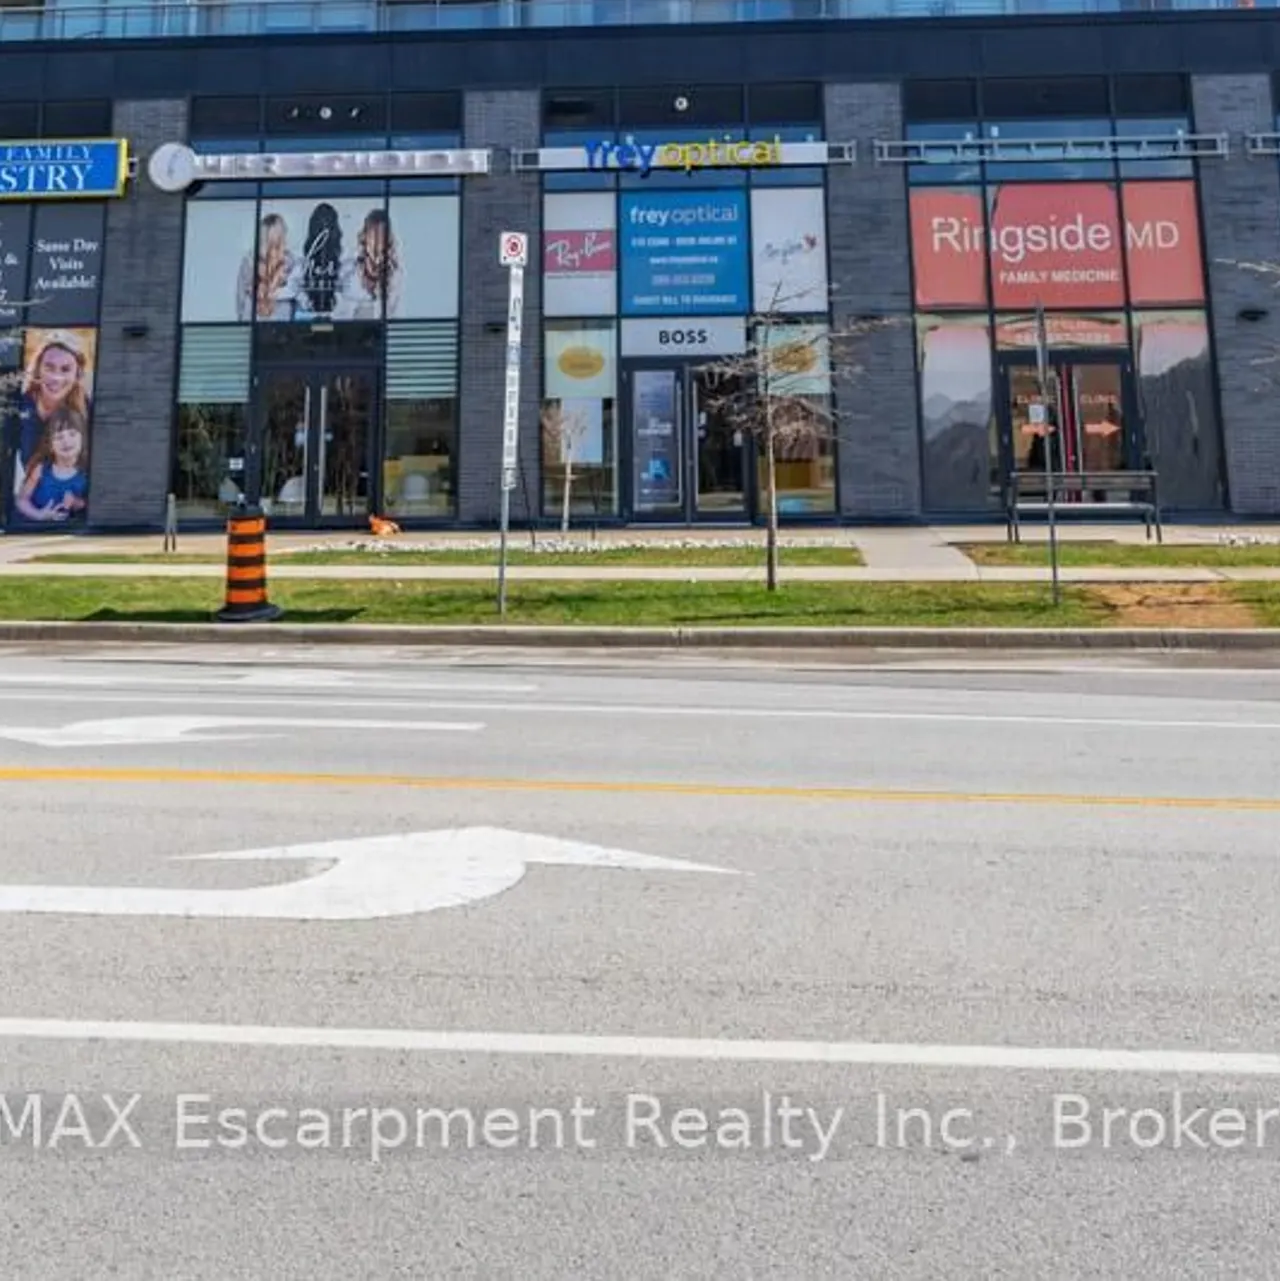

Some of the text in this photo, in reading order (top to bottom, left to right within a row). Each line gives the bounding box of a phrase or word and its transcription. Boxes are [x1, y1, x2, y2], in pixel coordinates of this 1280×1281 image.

[5, 145, 93, 161] FAMILY
[584, 134, 781, 178] frey optical
[630, 203, 738, 227] frey optical
[37, 238, 99, 253] Same Day
[931, 213, 1180, 262] Ringside MD
[1000, 268, 1120, 285] FAMILY MEDICINE
[658, 329, 709, 345] BOSS
